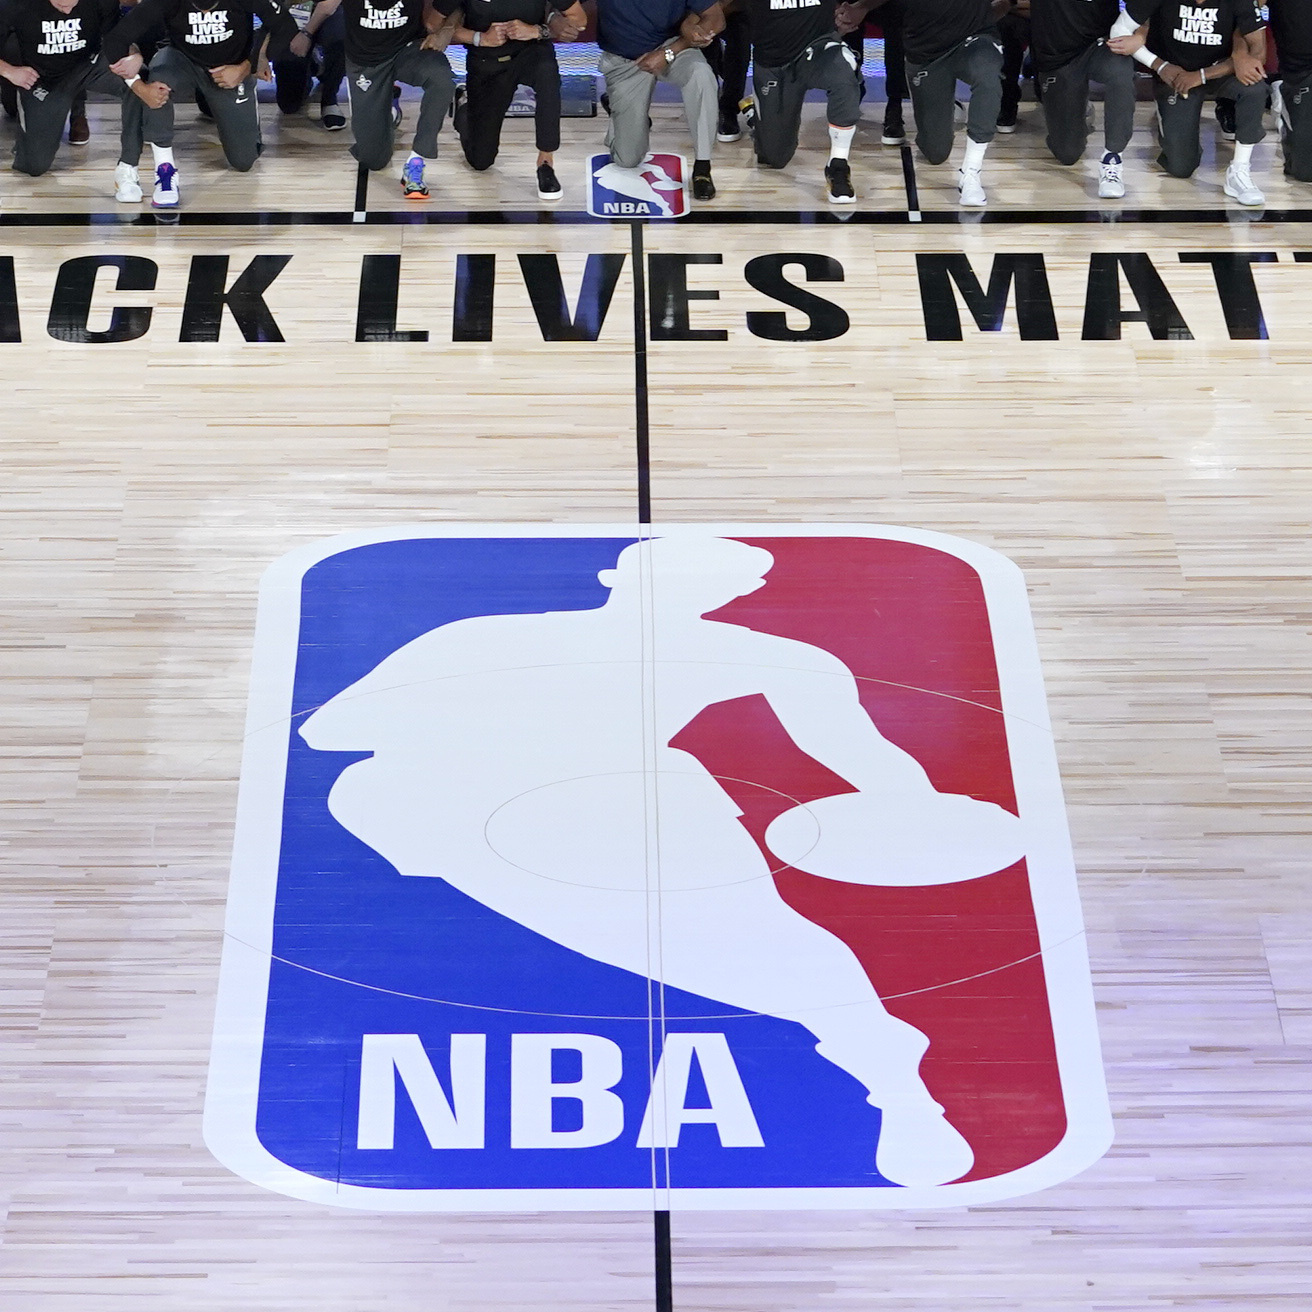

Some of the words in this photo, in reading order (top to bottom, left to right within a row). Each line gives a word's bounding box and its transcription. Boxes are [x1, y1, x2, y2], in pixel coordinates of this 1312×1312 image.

[188, 10, 229, 25] BLACK
[368, 8, 401, 19] LIVES
[1179, 4, 1219, 21] BLACK
[42, 18, 82, 34] BLACK
[193, 22, 225, 36] LIVES
[359, 16, 408, 29] MATTER
[1181, 18, 1214, 34] LIVES
[46, 31, 79, 45] LIVES
[185, 30, 234, 45] MATTER
[1173, 29, 1222, 45] MATTER
[38, 40, 86, 55] MATTER
[603, 202, 651, 214] NBA
[354, 252, 850, 343] LIVES
[356, 1032, 766, 1150] NBA
